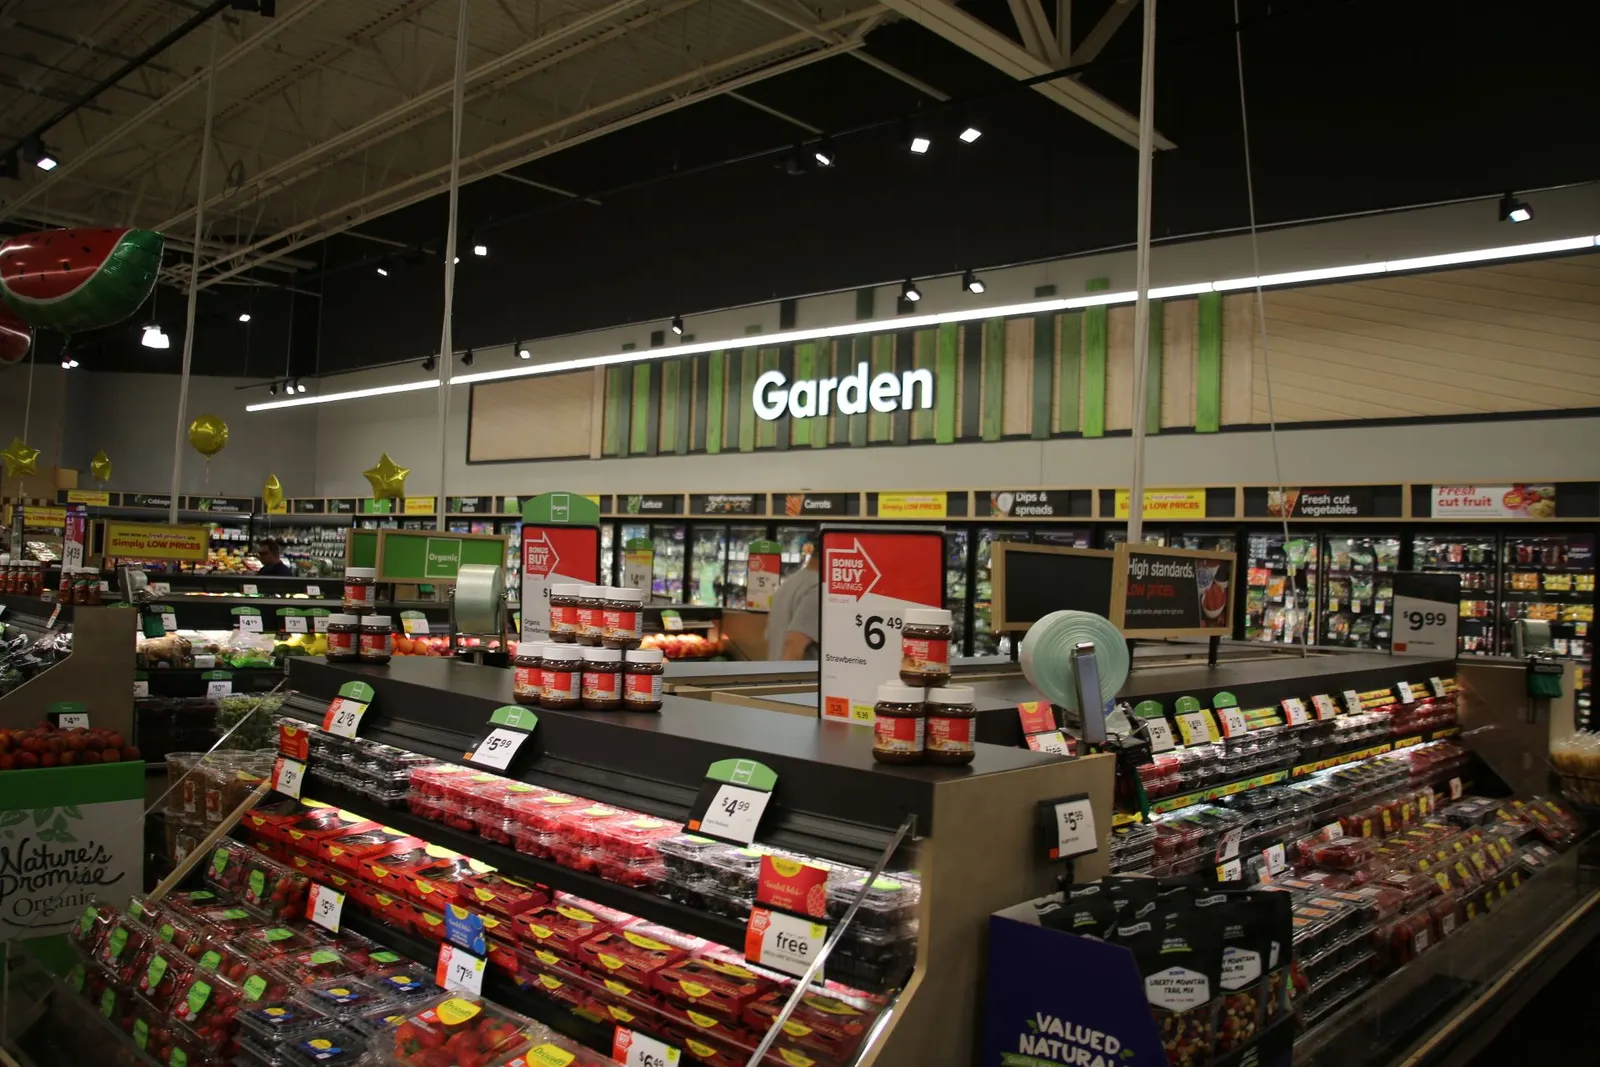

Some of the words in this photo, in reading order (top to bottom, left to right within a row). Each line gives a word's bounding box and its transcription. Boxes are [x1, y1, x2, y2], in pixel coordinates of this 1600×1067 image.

[753, 361, 933, 420] Garden
[1438, 485, 1476, 496] Fresh
[804, 499, 831, 509] Carrots
[1016, 492, 1037, 504] Dips
[1039, 492, 1047, 502] &
[1301, 495, 1333, 505] Fresh
[1336, 495, 1350, 505] cut
[1439, 498, 1459, 507] cut
[1463, 497, 1492, 506] fruit
[642, 501, 663, 509] Lettuce
[1015, 504, 1053, 516] spreads
[1170, 502, 1200, 510] PRICES
[1301, 505, 1357, 517] vegetables
[112, 538, 145, 549] Simply
[147, 540, 167, 548] LOW
[169, 541, 200, 550] PRICES
[528, 546, 549, 554] BONUS
[428, 553, 458, 563] Organic
[528, 554, 548, 565] BUY
[832, 559, 863, 568] BONUS
[1128, 557, 1148, 580] High
[1151, 561, 1195, 578] standards.
[832, 568, 863, 583] BUY
[832, 581, 863, 591] SAVINGS
[1127, 583, 1145, 597] Low
[524, 618, 541, 626] Organic
[825, 653, 867, 665] Strawberries
[0, 837, 113, 875] Nature's
[0, 866, 125, 906] Promise
[13, 889, 96, 917] Organic
[777, 932, 808, 955] free
[1228, 956, 1256, 965] MOUNTAIN
[1036, 1011, 1121, 1055] VALUED
[1019, 1033, 1122, 1067] NATURA
